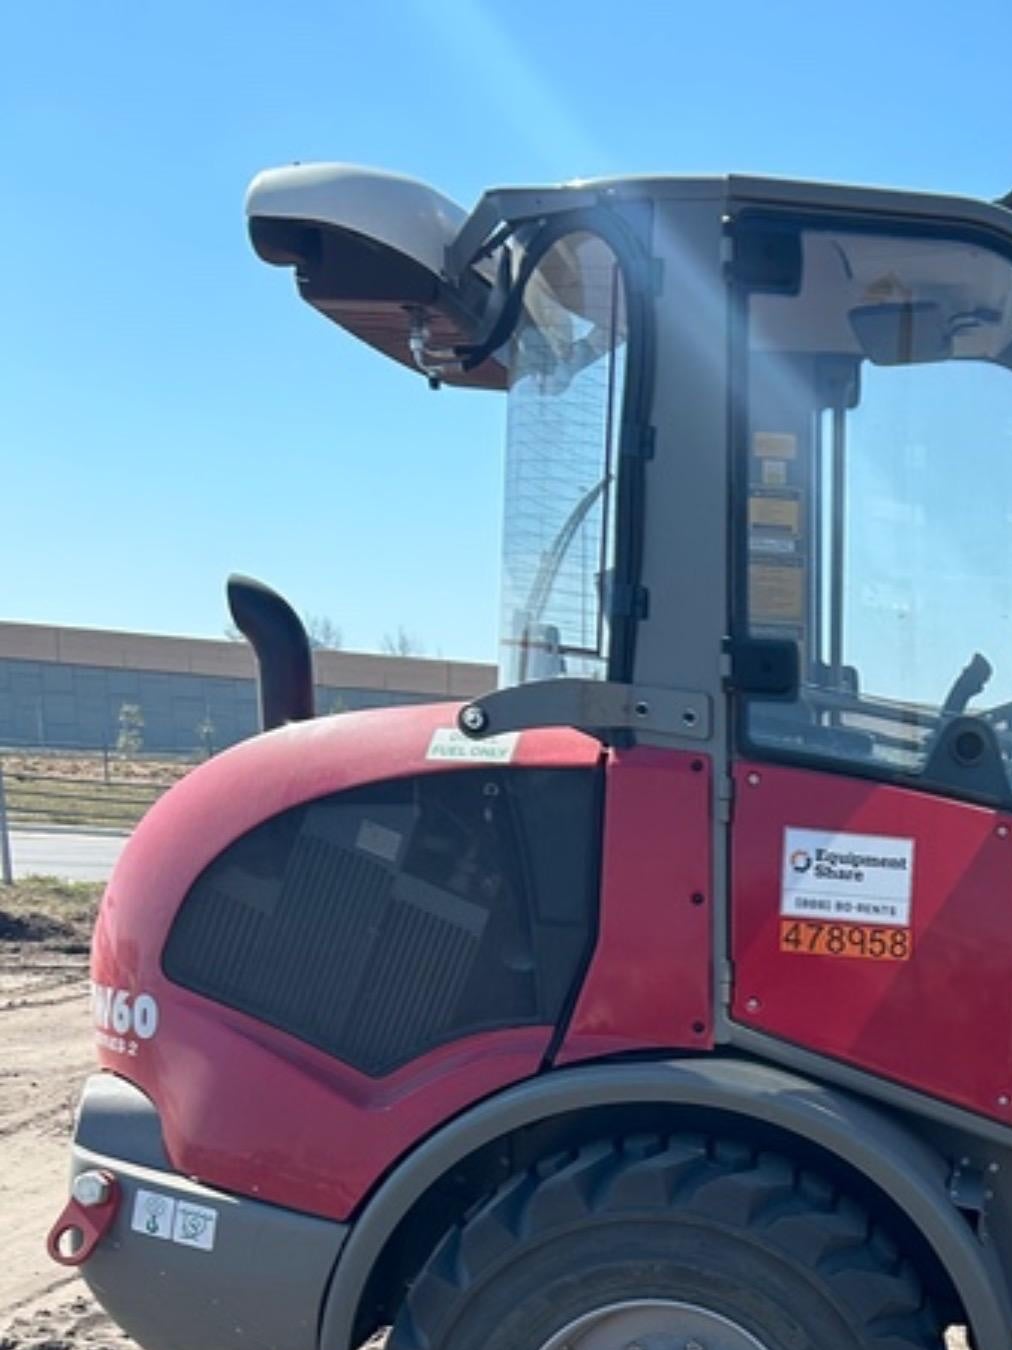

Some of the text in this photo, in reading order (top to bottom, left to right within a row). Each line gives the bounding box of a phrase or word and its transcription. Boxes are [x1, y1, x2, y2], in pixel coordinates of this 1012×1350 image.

[432, 744, 508, 757] FUEL ONLY
[815, 848, 907, 870] Equipment
[815, 864, 863, 881] Share
[784, 923, 907, 957] 478958
